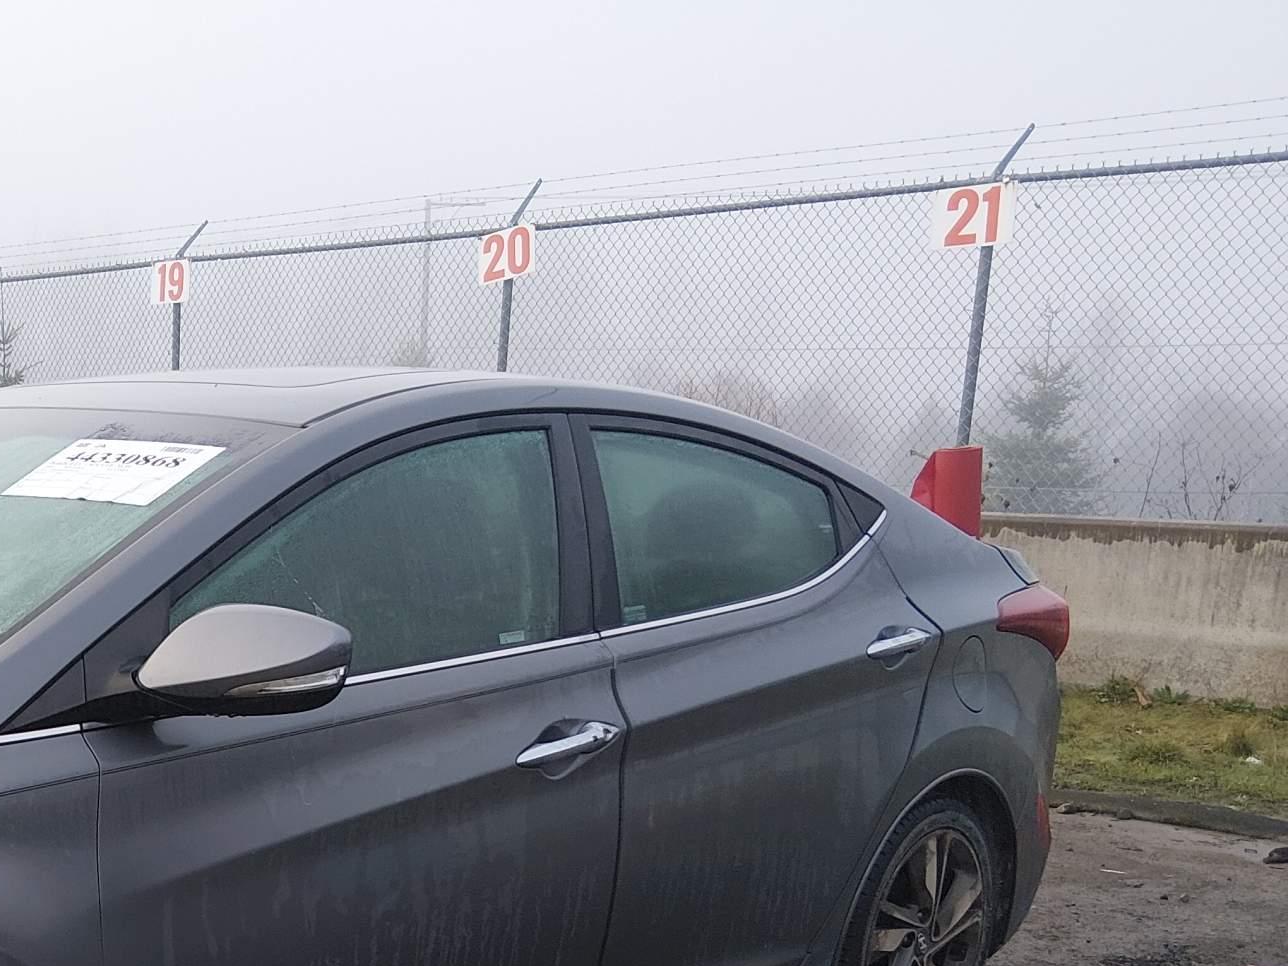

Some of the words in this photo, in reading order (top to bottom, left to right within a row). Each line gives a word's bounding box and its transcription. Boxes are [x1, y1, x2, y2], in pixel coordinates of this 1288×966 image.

[943, 186, 1001, 247] 21
[483, 226, 531, 283] 20
[158, 262, 184, 302] 19
[66, 451, 187, 468] 44330868
